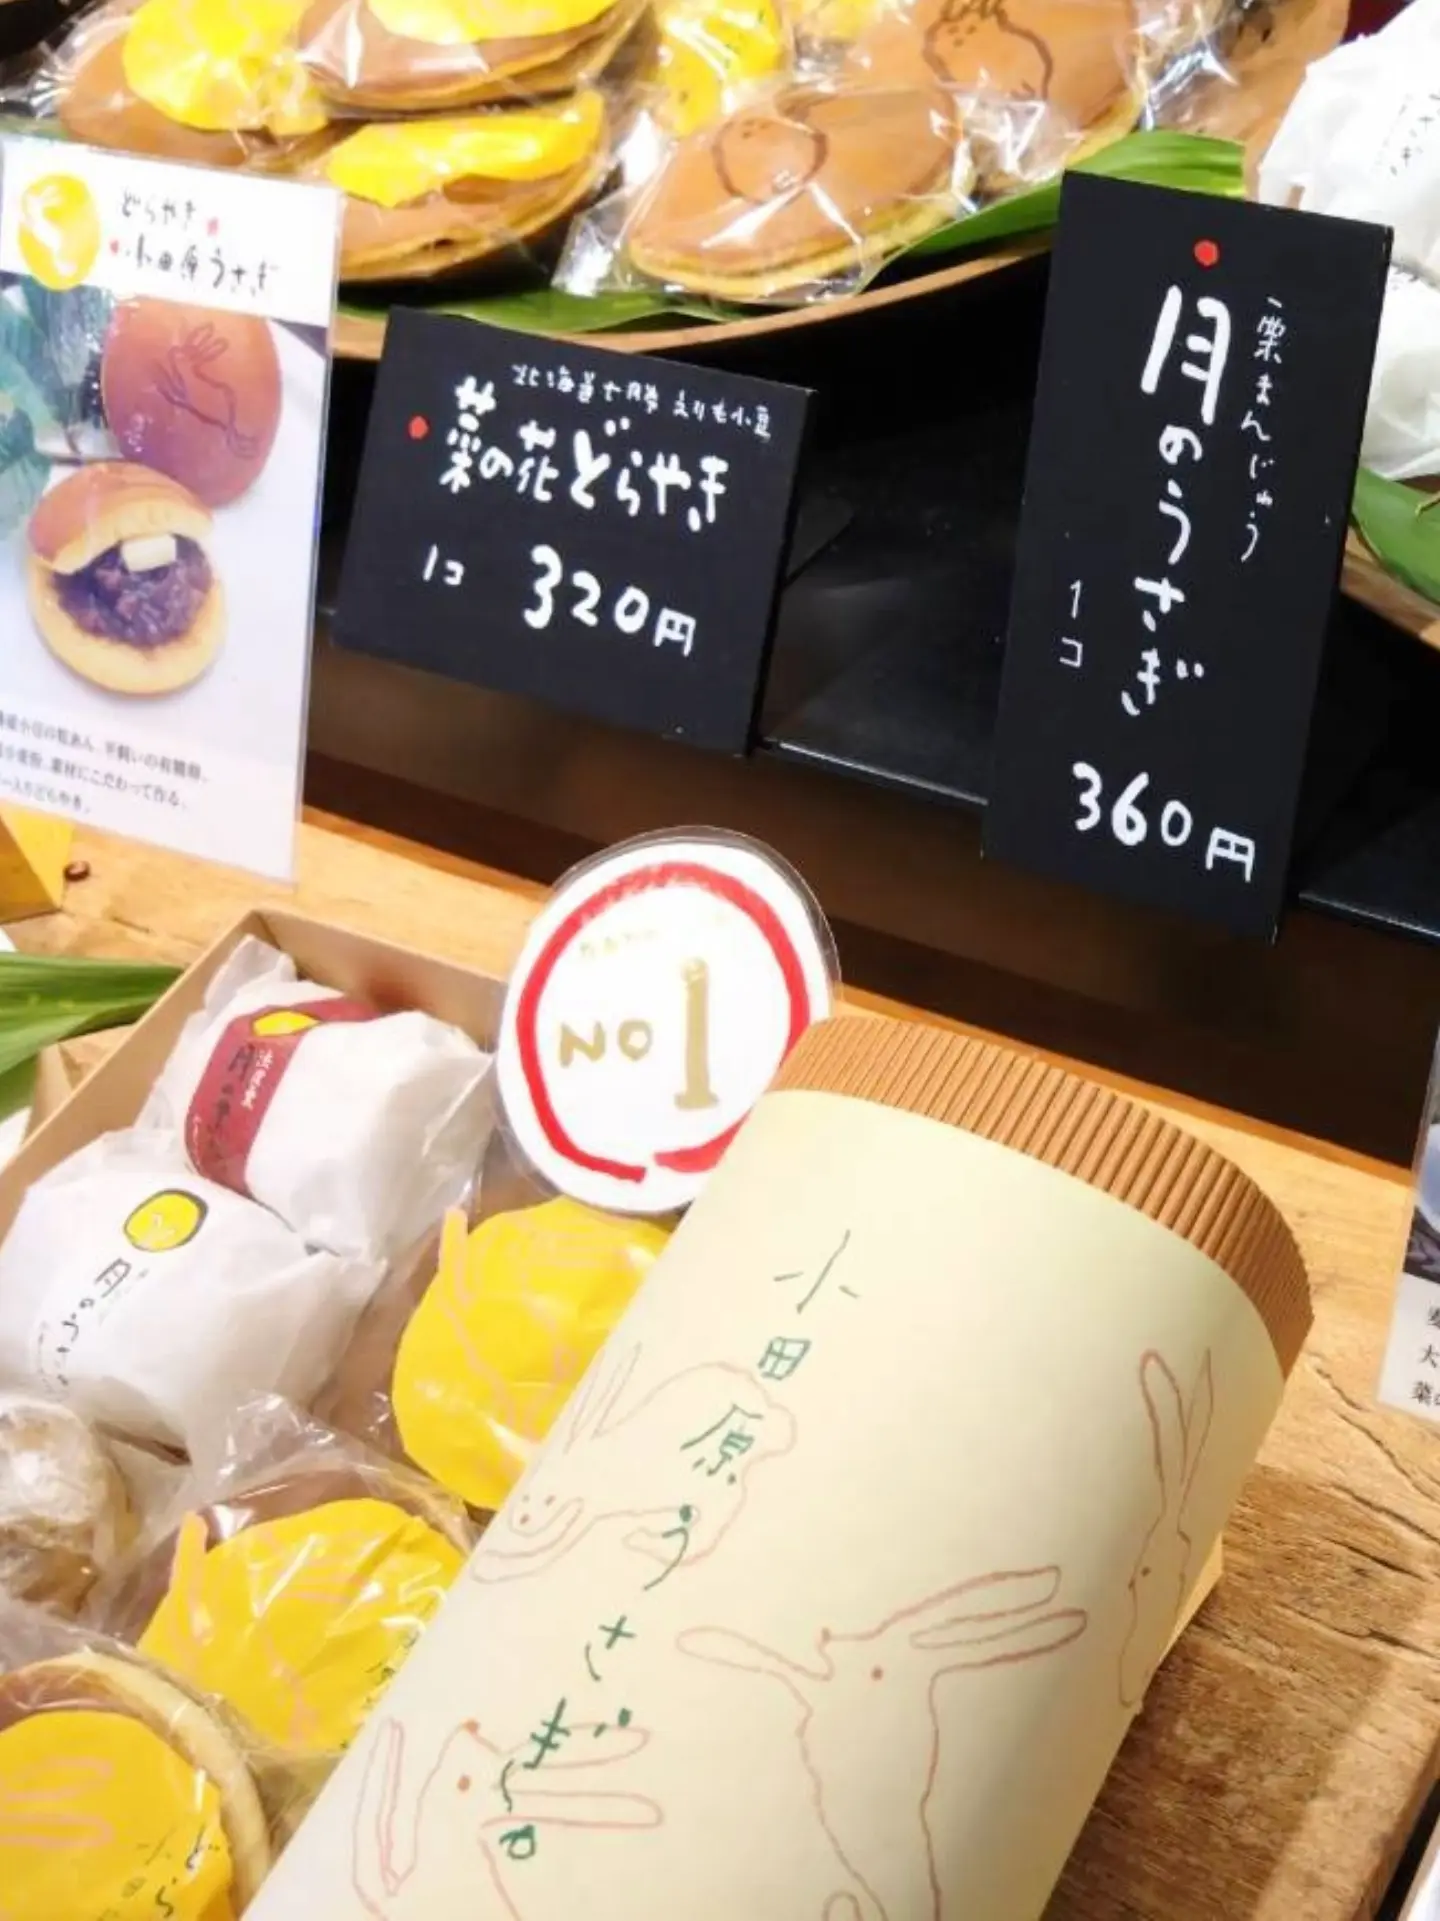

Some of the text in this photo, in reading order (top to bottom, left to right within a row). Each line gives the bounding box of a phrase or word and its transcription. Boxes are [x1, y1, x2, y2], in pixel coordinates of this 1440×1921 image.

[438, 374, 730, 533] 菜の花どらやき
[1120, 284, 1231, 717] 月のうさぎ
[1240, 314, 1287, 562] 栗まんじゅう
[522, 543, 698, 658] 320円
[1071, 761, 1256, 883] 360円
